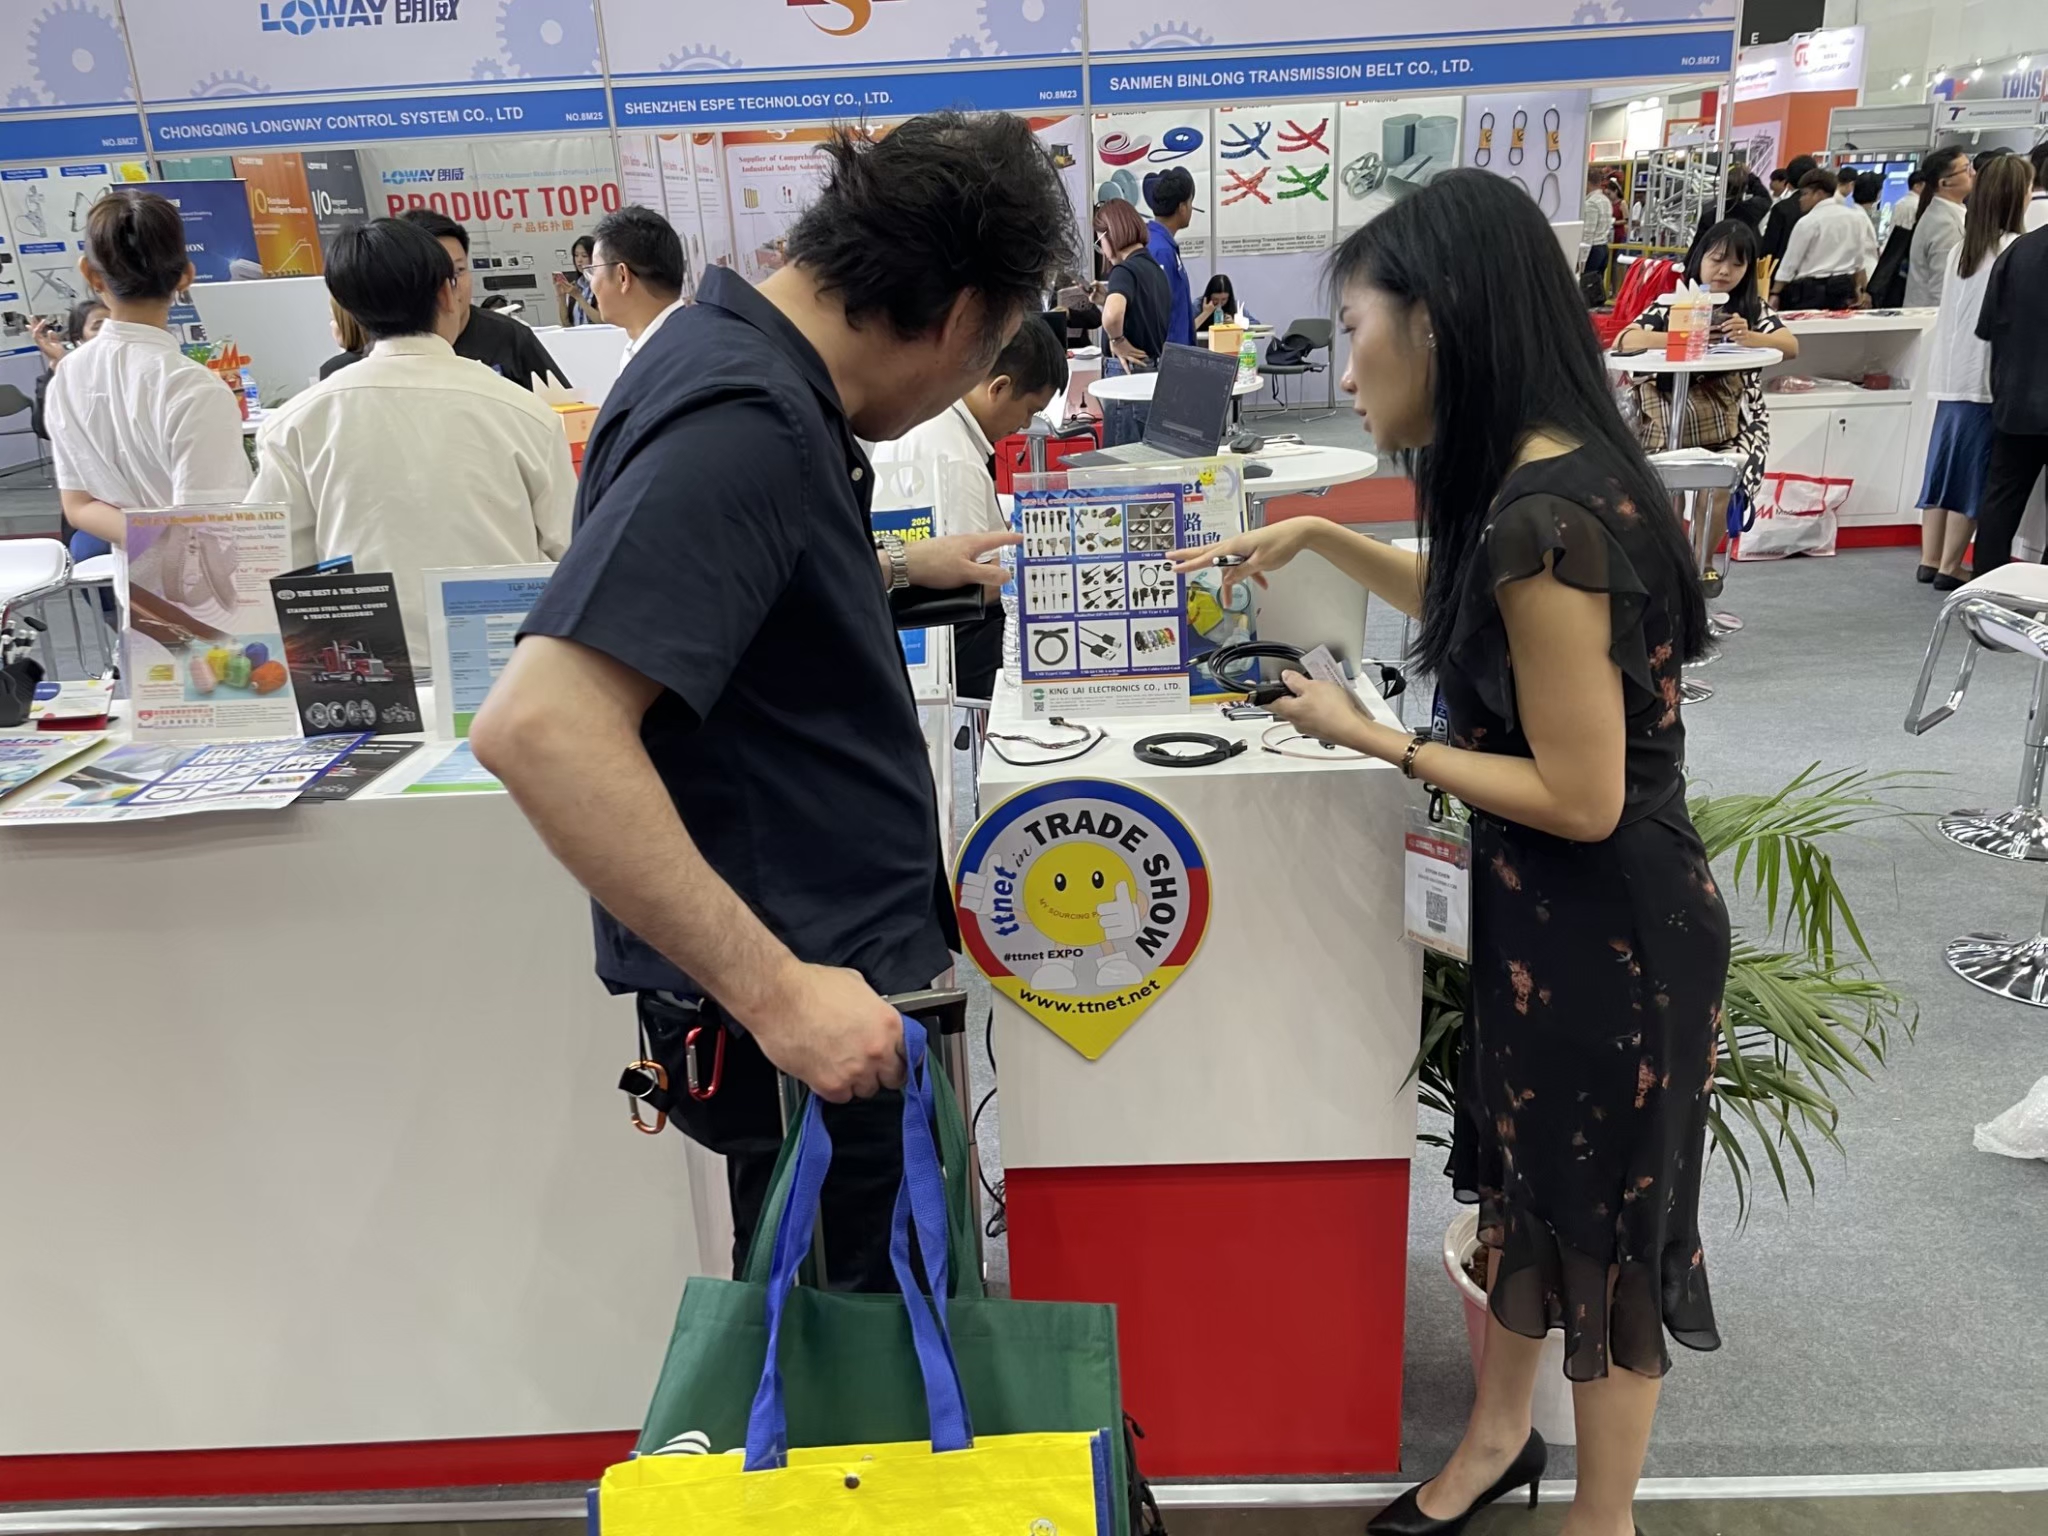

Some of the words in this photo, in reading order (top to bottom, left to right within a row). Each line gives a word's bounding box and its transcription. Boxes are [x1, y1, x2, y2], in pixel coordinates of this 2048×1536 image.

[1681, 55, 1720, 66] NO.8M21
[1109, 75, 1173, 91] SANMEN
[1177, 71, 1245, 88] BINLONG
[1249, 65, 1362, 83] TRANSMISSION
[1366, 62, 1404, 78] BELT
[1407, 61, 1438, 76] CO.,
[1442, 59, 1474, 73] LTD.
[1039, 90, 1078, 100] NO.8M23
[625, 99, 697, 115] SHENZHEN
[700, 98, 736, 112] ESPE
[738, 94, 831, 110] TECHNOLOGY
[834, 93, 861, 107] CO.,
[865, 91, 894, 104] LTD.
[159, 122, 248, 140] CHONGQING
[251, 117, 323, 134] LONGWAY
[326, 114, 398, 130] CONTROL
[400, 110, 460, 126] SYSTEM
[463, 108, 493, 123] CO.,
[496, 106, 523, 121] LTD
[565, 112, 604, 122] NO.8M25
[102, 137, 138, 147] NO.8M27
[742, 165, 774, 173] Industrial
[382, 169, 436, 185] LOWAY
[437, 167, 465, 182] 朗威
[386, 188, 530, 221] PRODUCT
[512, 220, 575, 233] 产品拓扑图
[208, 513, 233, 522] World
[236, 512, 256, 521] With
[258, 511, 285, 520] ATICS
[911, 516, 931, 527] 2024
[296, 590, 312, 598] THE
[313, 589, 331, 597] BEST
[286, 606, 320, 614] STAINLESS
[332, 611, 374, 619] ACCESSORIES
[1049, 687, 1069, 695] KING
[1072, 687, 1085, 695] LAI
[1088, 684, 1140, 694] ELECTRONICS
[1144, 683, 1160, 692] CO.,
[1164, 682, 1182, 691] LTD.
[990, 865, 1020, 937] ttnet
[1012, 844, 1033, 868] in
[1023, 810, 1148, 854] TRADE
[1134, 853, 1178, 959] SHOW
[1039, 898, 1050, 910] MY
[1049, 908, 1091, 920] SOURCING
[1003, 950, 1044, 962] #ttnet
[1047, 948, 1084, 960] EXPO
[1019, 979, 1161, 1014] www.ttnet.net
